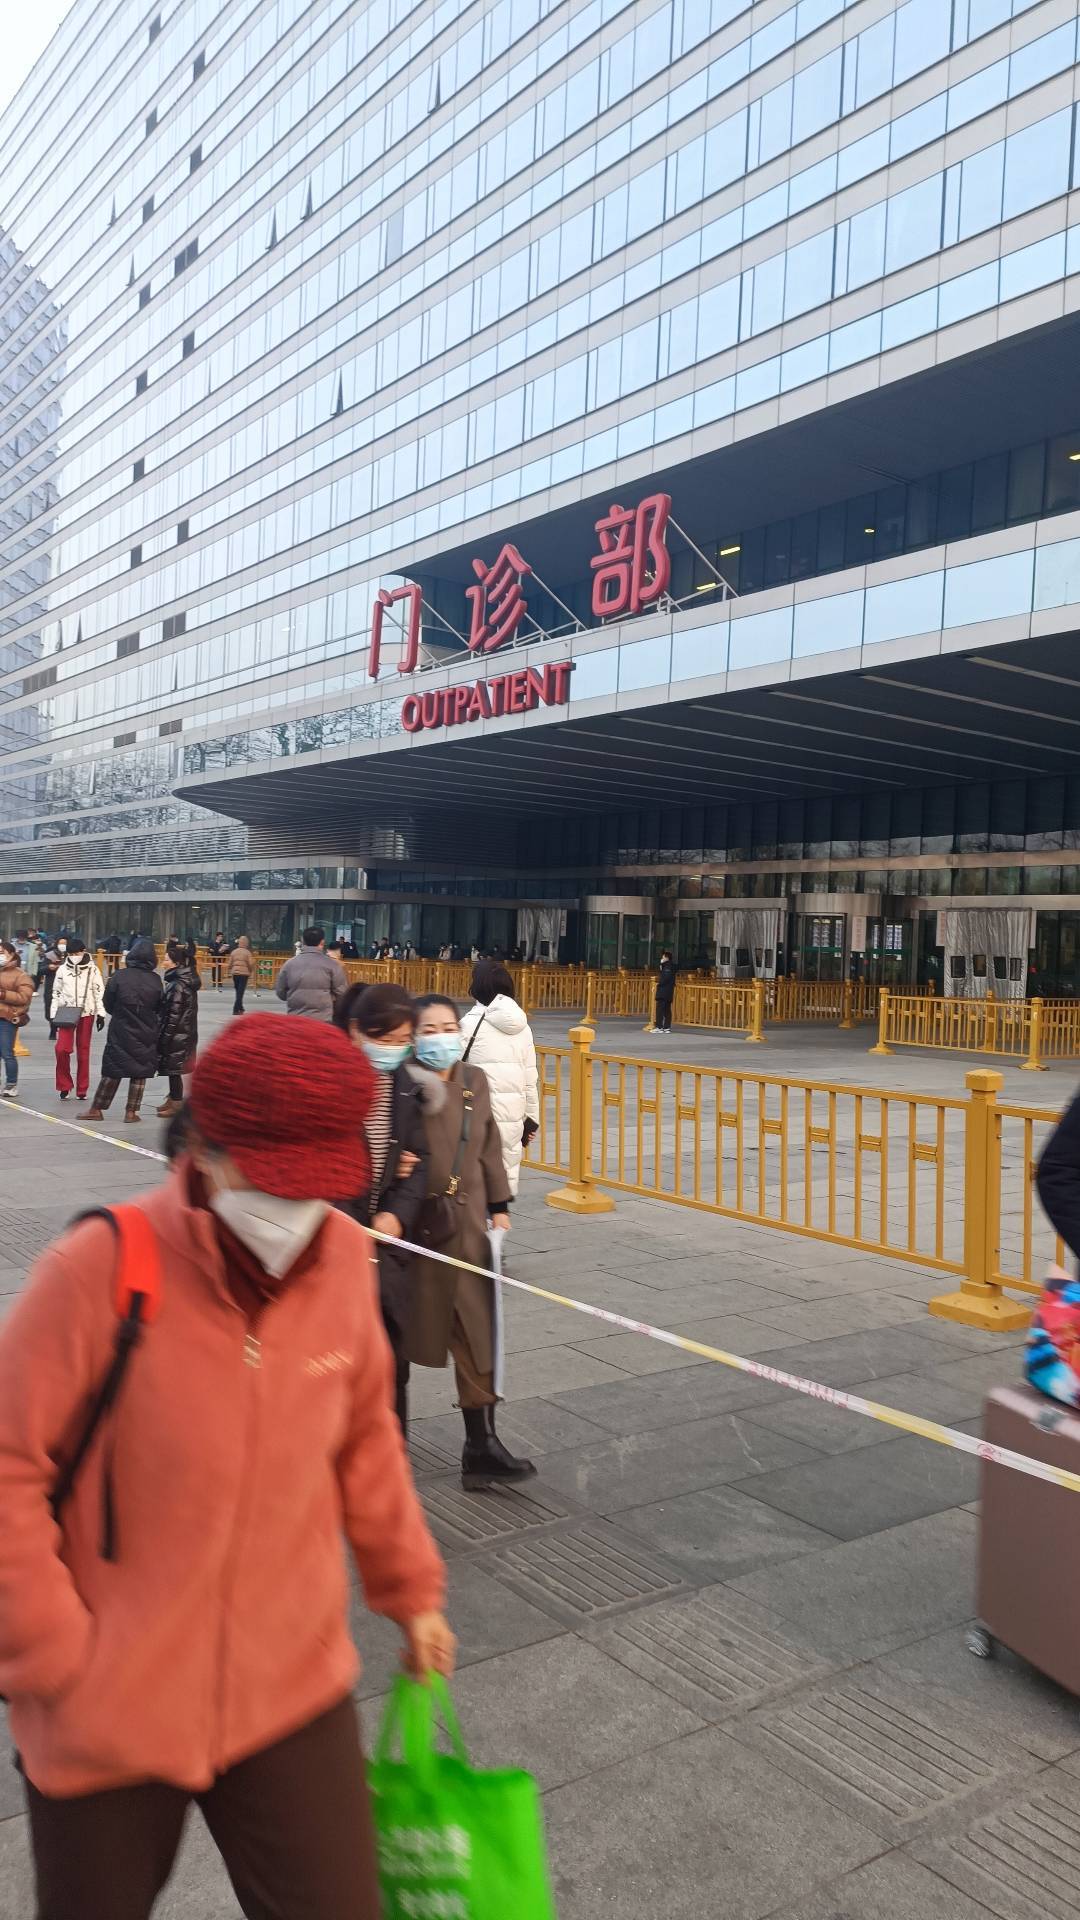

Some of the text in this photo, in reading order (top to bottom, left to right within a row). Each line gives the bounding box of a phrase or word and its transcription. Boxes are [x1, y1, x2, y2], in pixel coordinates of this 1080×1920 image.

[368, 492, 672, 678] 门诊部
[402, 661, 574, 732] OUTPATIENT
